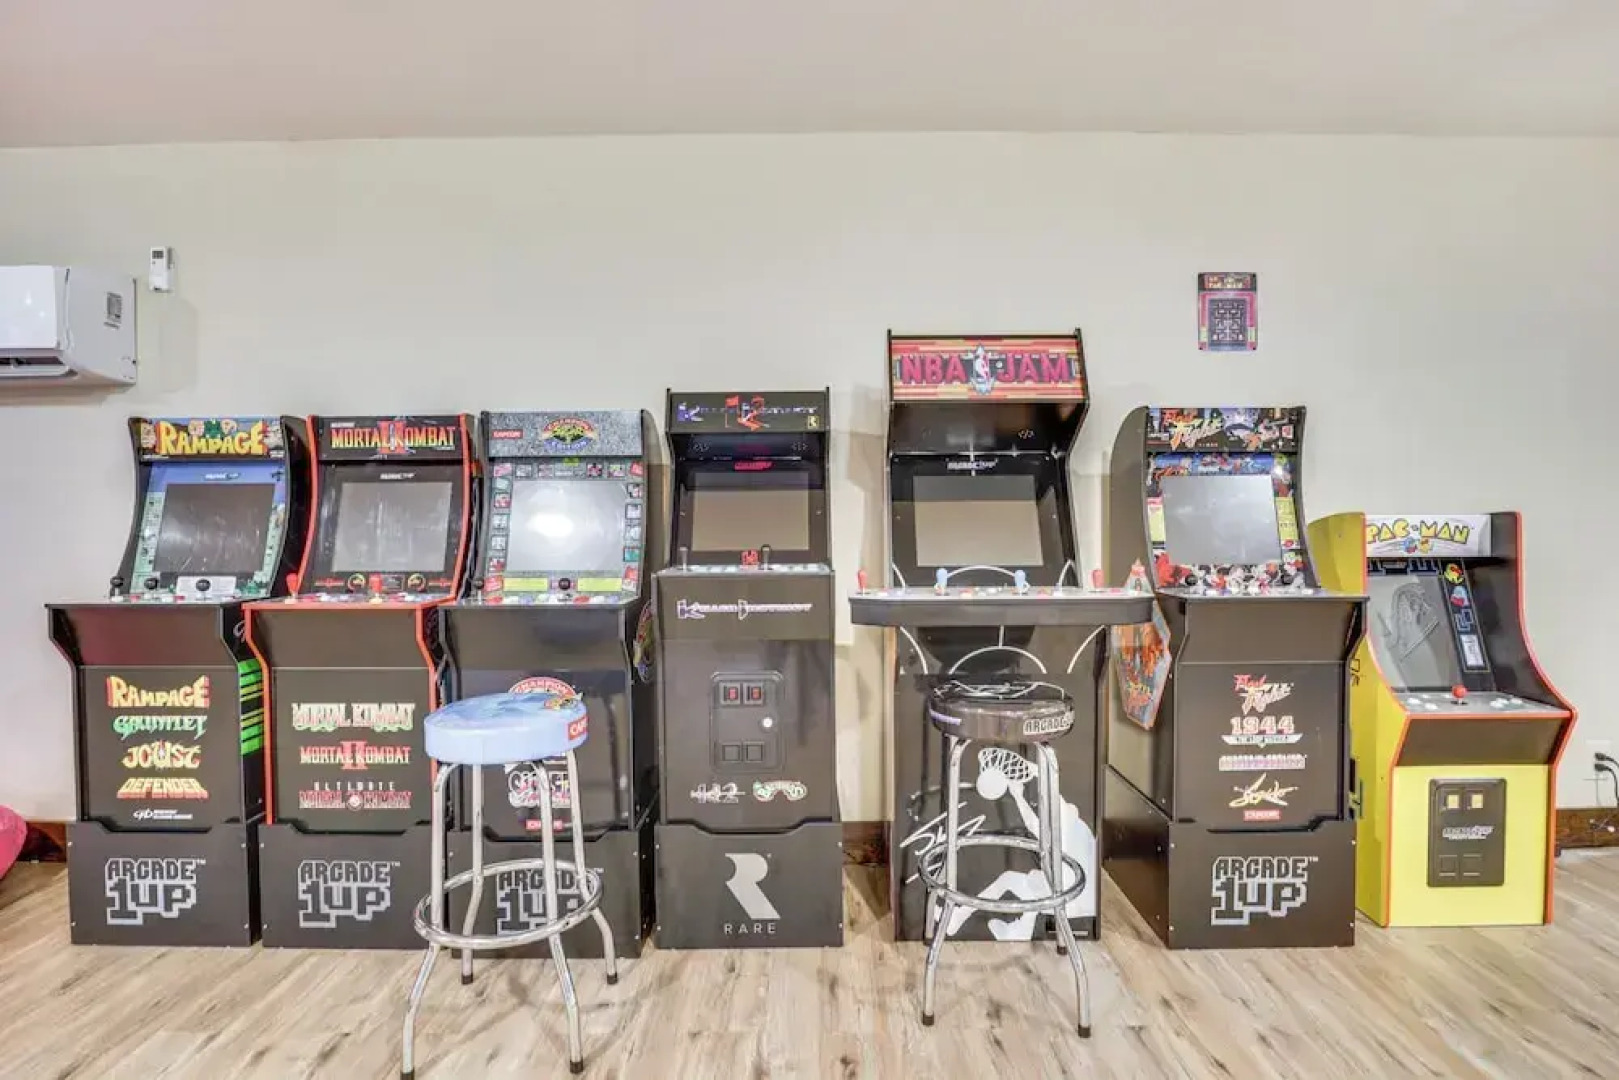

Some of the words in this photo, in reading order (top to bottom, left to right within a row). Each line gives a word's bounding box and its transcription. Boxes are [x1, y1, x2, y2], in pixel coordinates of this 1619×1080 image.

[901, 352, 967, 384] NBA
[996, 352, 1070, 382] JAM
[155, 420, 268, 455] RAMPAGE
[331, 428, 391, 448] MORTAL
[393, 427, 456, 447] KOMBAT
[106, 675, 210, 709] RAMPAGE
[112, 715, 208, 740] GAUNTLET
[1230, 715, 1295, 734] 1944
[121, 740, 202, 769] JOUST
[300, 746, 353, 764] MORTAL
[354, 746, 412, 764] KOMBAT
[116, 776, 208, 799] DEFENDER
[105, 858, 197, 882] ARCADE
[299, 860, 391, 884] ARCADE
[1213, 857, 1308, 882] ARCADE
[106, 876, 196, 925] 1UP
[299, 880, 391, 928] 1UP
[1211, 878, 1307, 925] 1UP
[724, 922, 777, 935] RARE
